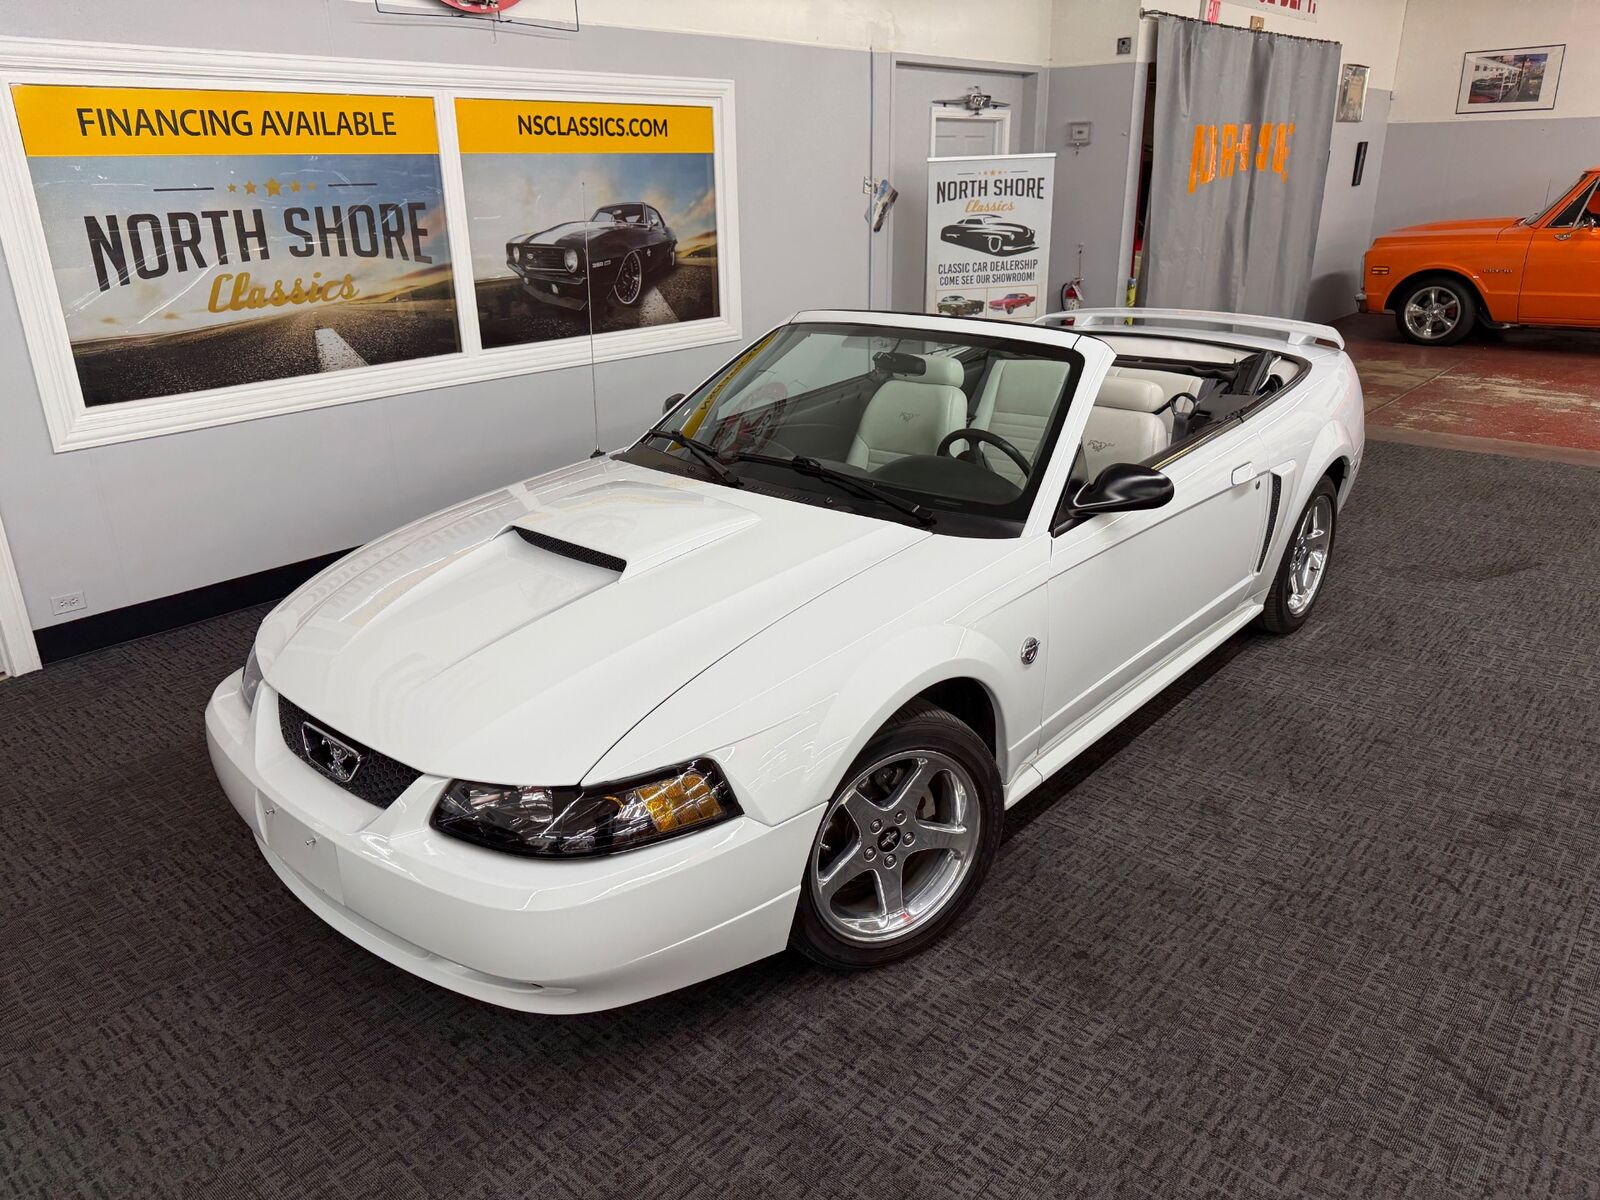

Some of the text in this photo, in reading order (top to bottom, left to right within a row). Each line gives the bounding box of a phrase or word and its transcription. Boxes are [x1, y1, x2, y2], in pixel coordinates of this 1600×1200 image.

[76, 107, 397, 137] FINANCING AVAILABLE
[517, 114, 669, 138] NSCLASSICS.COM
[937, 178, 1045, 204] NORTH SHORE
[965, 200, 1015, 212] Classics
[83, 202, 434, 293] NORTH SHORE
[938, 259, 1038, 274] CLASSIC CAR DEALERSHIP
[939, 272, 1035, 286] COME SEE OUR SHOWROOM!
[207, 271, 360, 315] Classics
